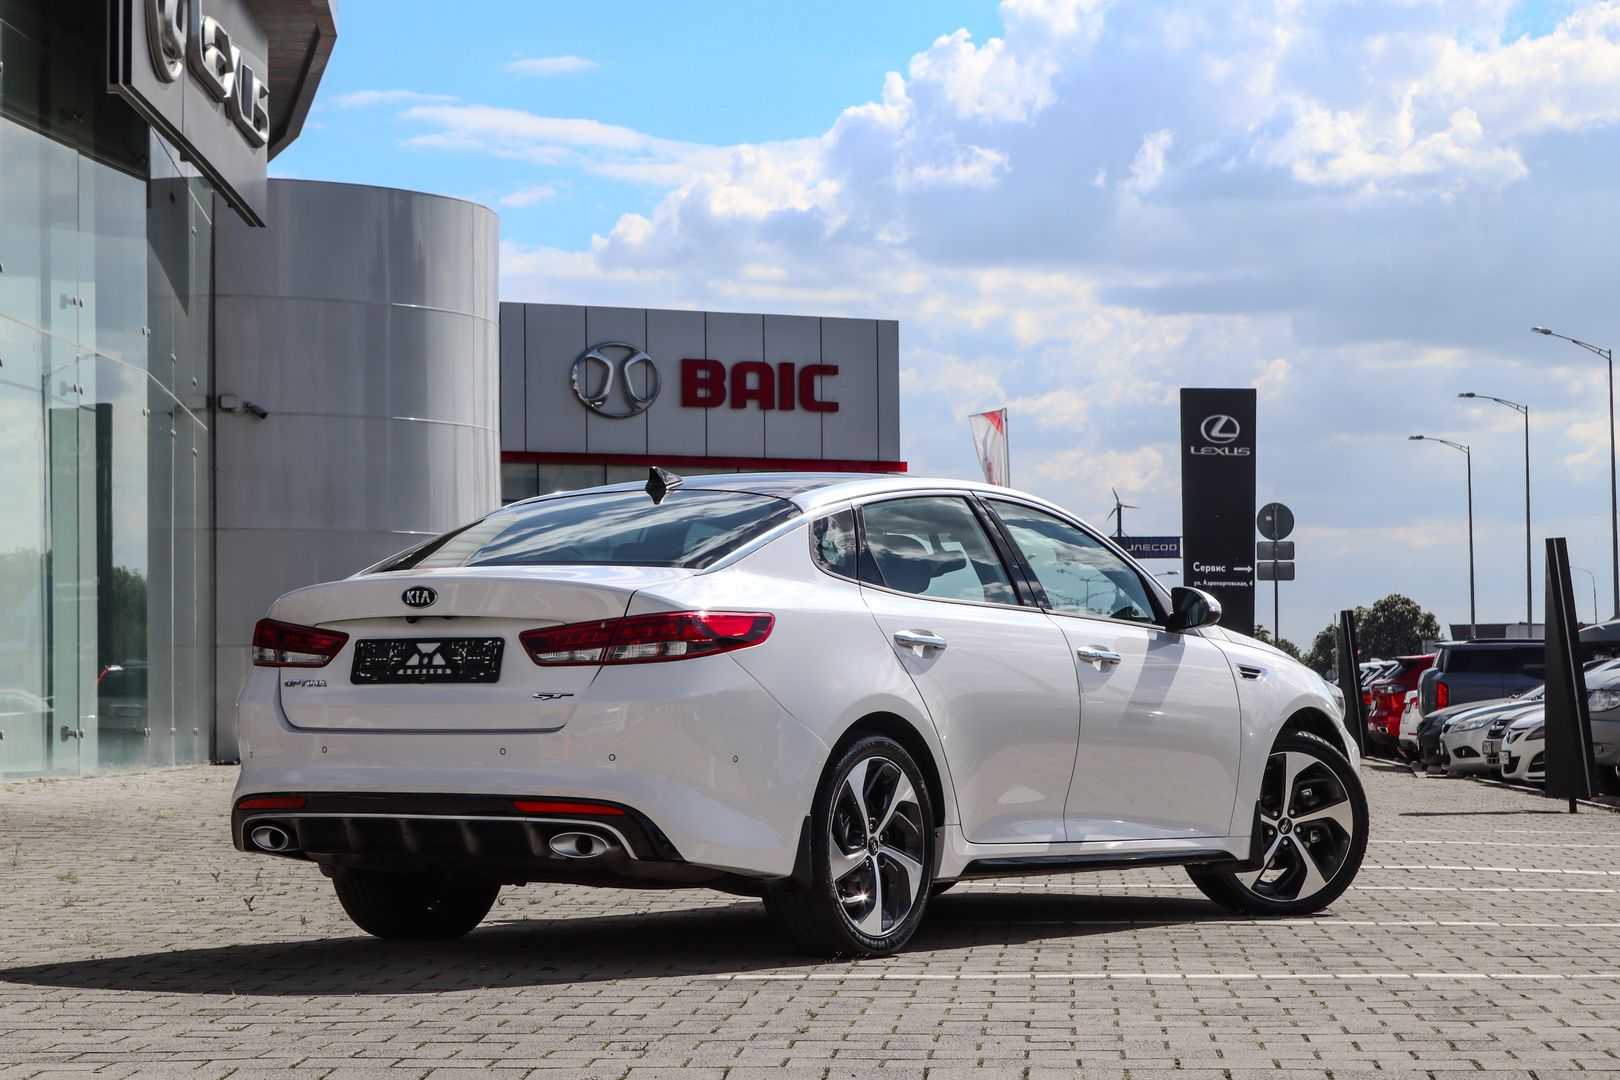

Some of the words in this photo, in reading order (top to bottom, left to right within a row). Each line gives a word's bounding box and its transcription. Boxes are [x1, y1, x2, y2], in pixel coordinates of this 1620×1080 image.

[680, 358, 839, 412] BAIC
[1190, 446, 1250, 456] LEXUS
[1193, 561, 1226, 573] Сервис
[406, 590, 431, 604] KIA
